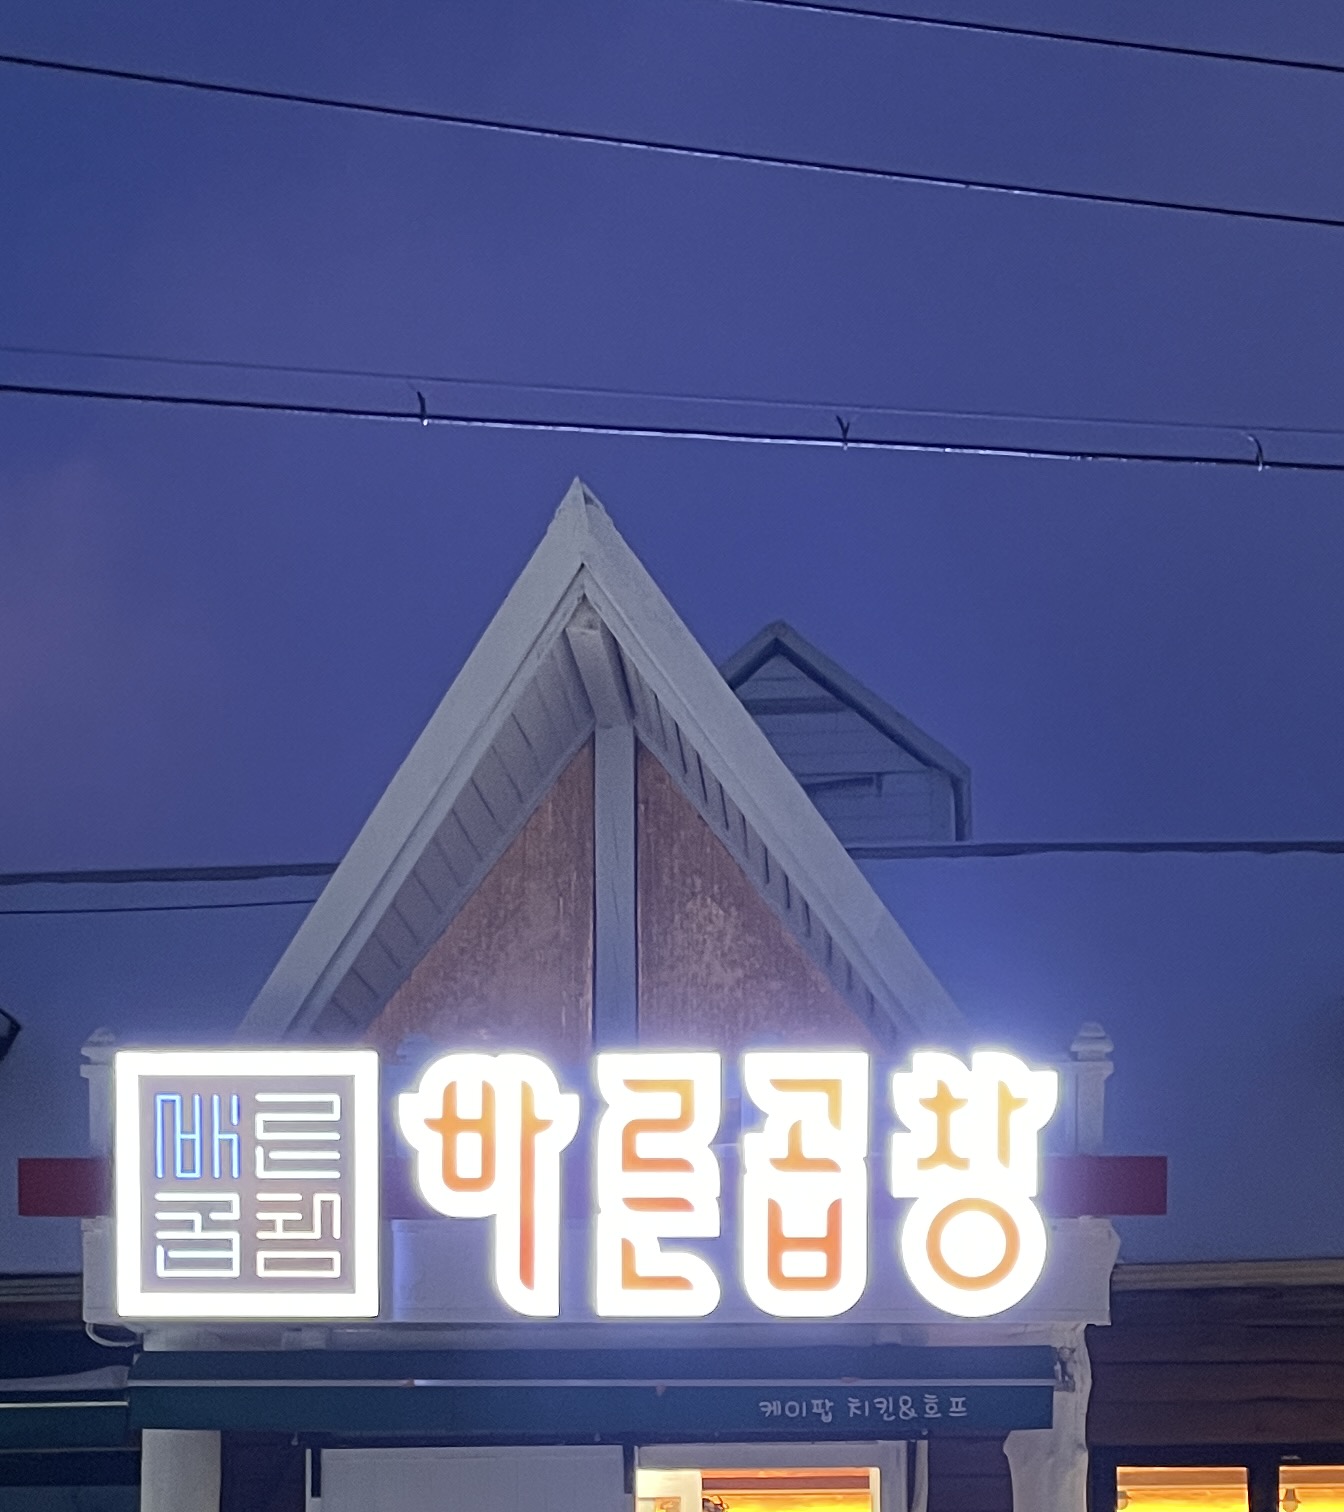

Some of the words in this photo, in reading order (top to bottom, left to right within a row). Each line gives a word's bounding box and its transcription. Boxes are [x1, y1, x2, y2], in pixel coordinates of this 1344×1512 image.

[398, 1050, 1059, 1318] 바른곱창
[758, 1398, 835, 1424] 케이팝
[846, 1393, 969, 1422] 치킨&호프
